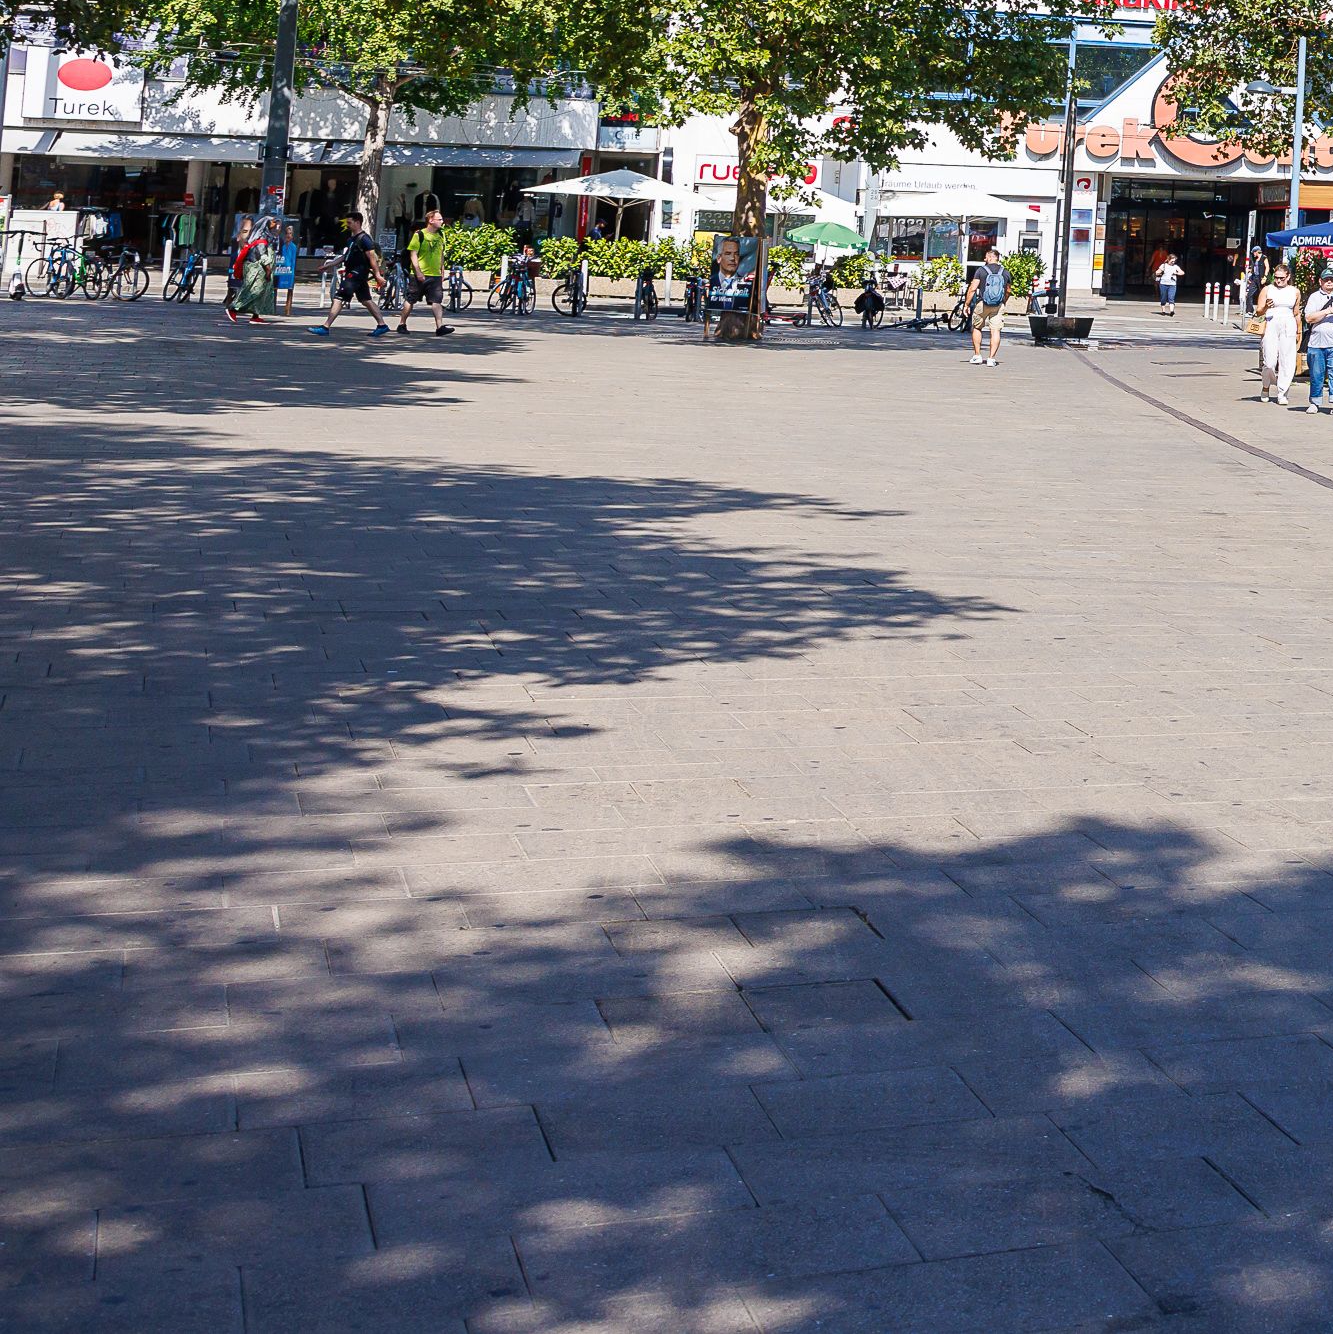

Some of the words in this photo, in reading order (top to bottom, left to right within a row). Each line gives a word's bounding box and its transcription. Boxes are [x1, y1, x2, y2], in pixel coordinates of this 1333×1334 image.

[49, 97, 114, 116] Turek
[1000, 109, 1157, 160] urek
[914, 180, 943, 189] Urlaub
